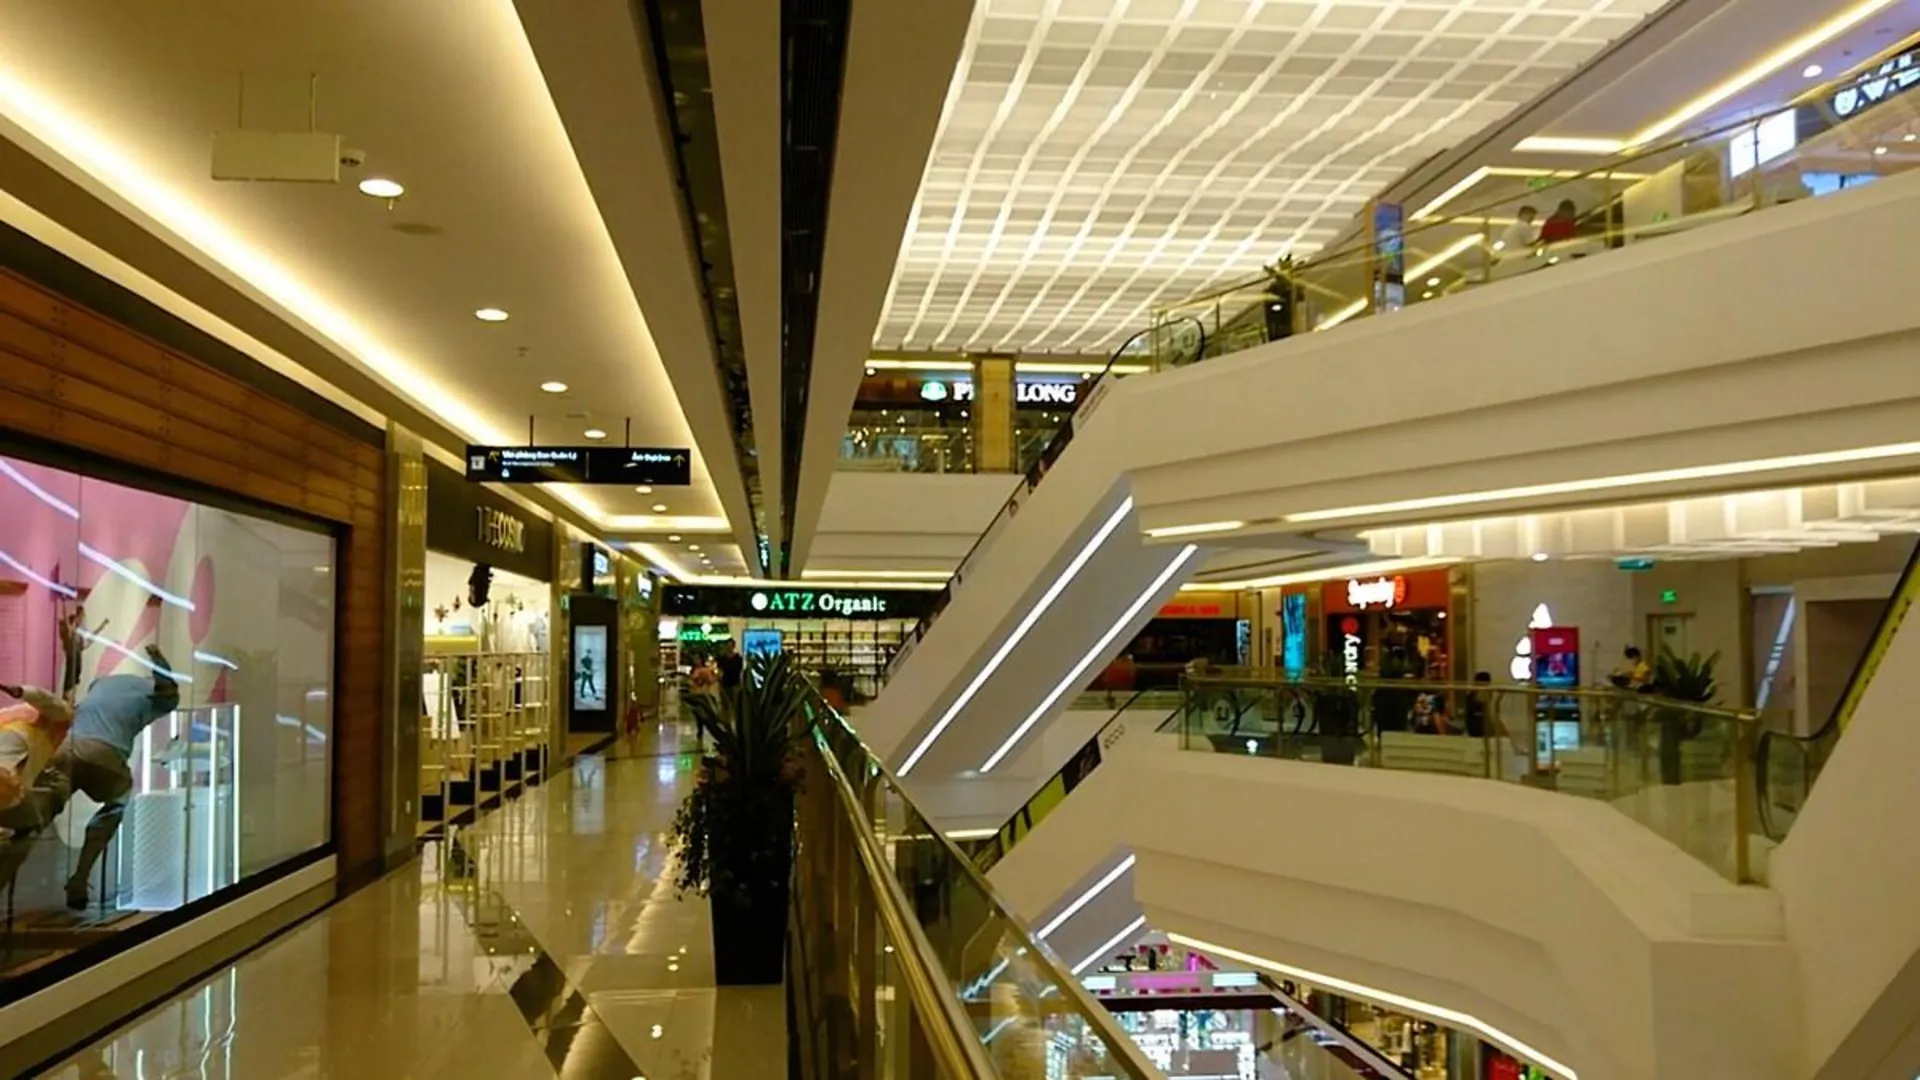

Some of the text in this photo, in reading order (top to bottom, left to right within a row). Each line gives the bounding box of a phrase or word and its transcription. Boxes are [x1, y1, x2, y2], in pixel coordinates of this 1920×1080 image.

[1017, 383, 1076, 403] LONG
[770, 592, 886, 616] ATZ Organic
